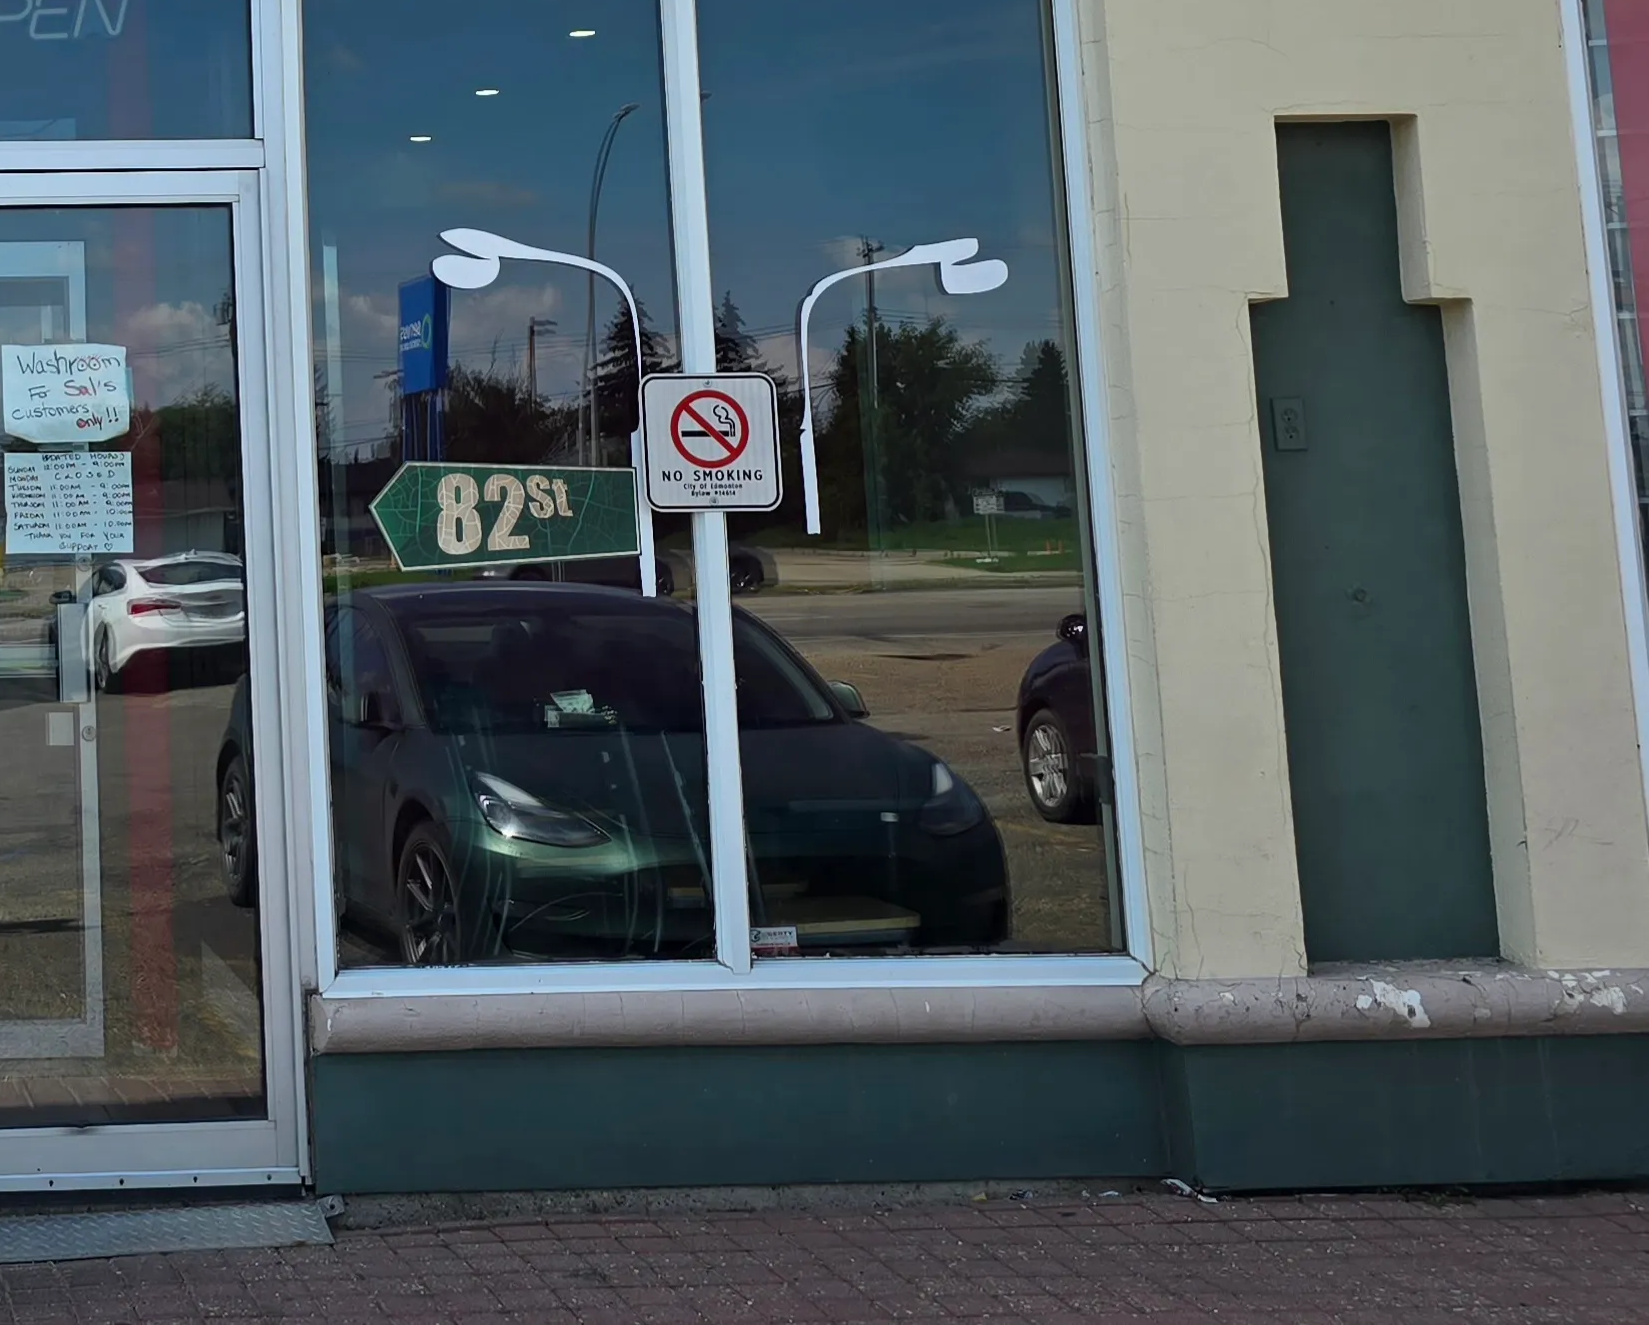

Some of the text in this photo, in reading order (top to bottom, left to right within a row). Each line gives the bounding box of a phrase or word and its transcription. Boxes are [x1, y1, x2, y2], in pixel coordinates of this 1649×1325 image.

[16, 349, 120, 375] Washroom
[63, 376, 117, 396] Sal's
[662, 469, 763, 482] NO SMOKING
[436, 472, 574, 555] 82 St
